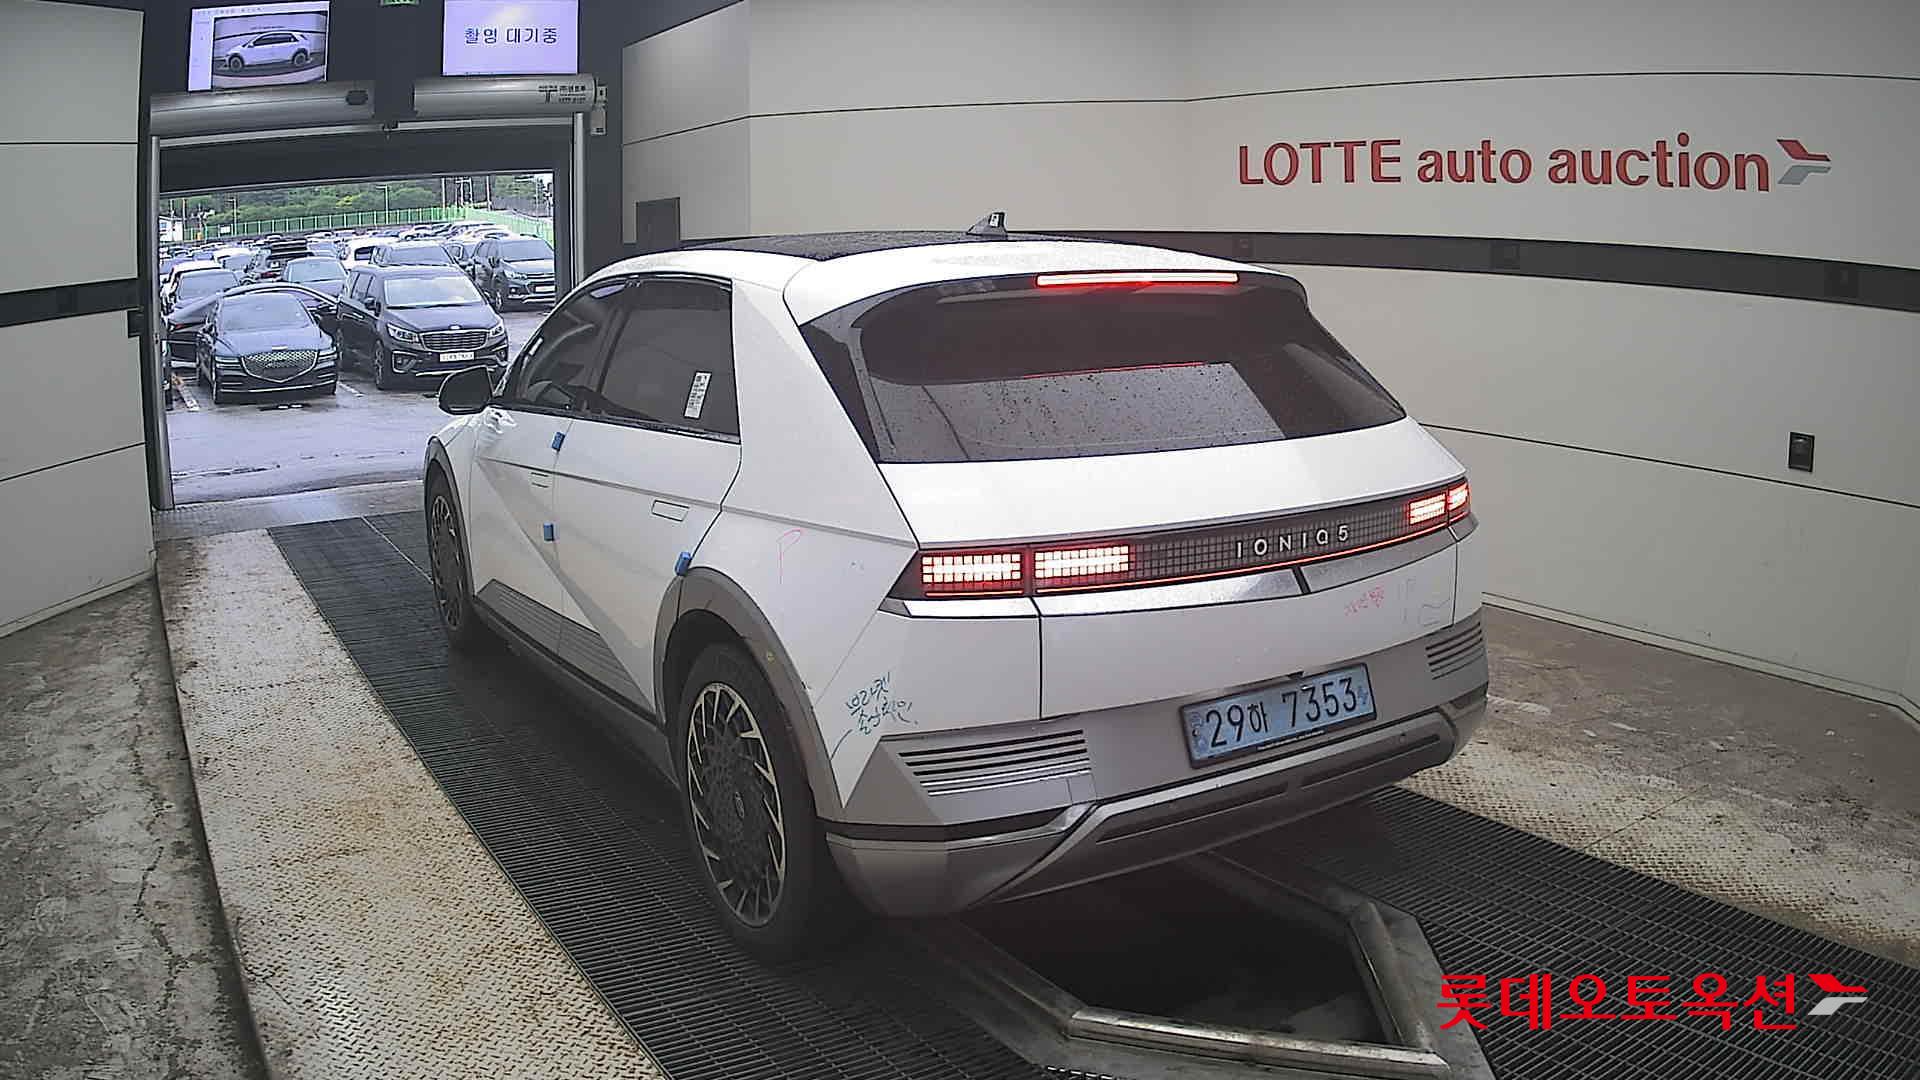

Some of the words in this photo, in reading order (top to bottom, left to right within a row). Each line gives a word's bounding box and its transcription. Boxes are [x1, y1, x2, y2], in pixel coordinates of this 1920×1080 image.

[1239, 139, 1402, 185] LOTTE
[1417, 139, 1532, 184] auto
[1548, 132, 1769, 192] auction
[1205, 701, 1269, 748] 29하
[1281, 676, 1358, 728] 7353
